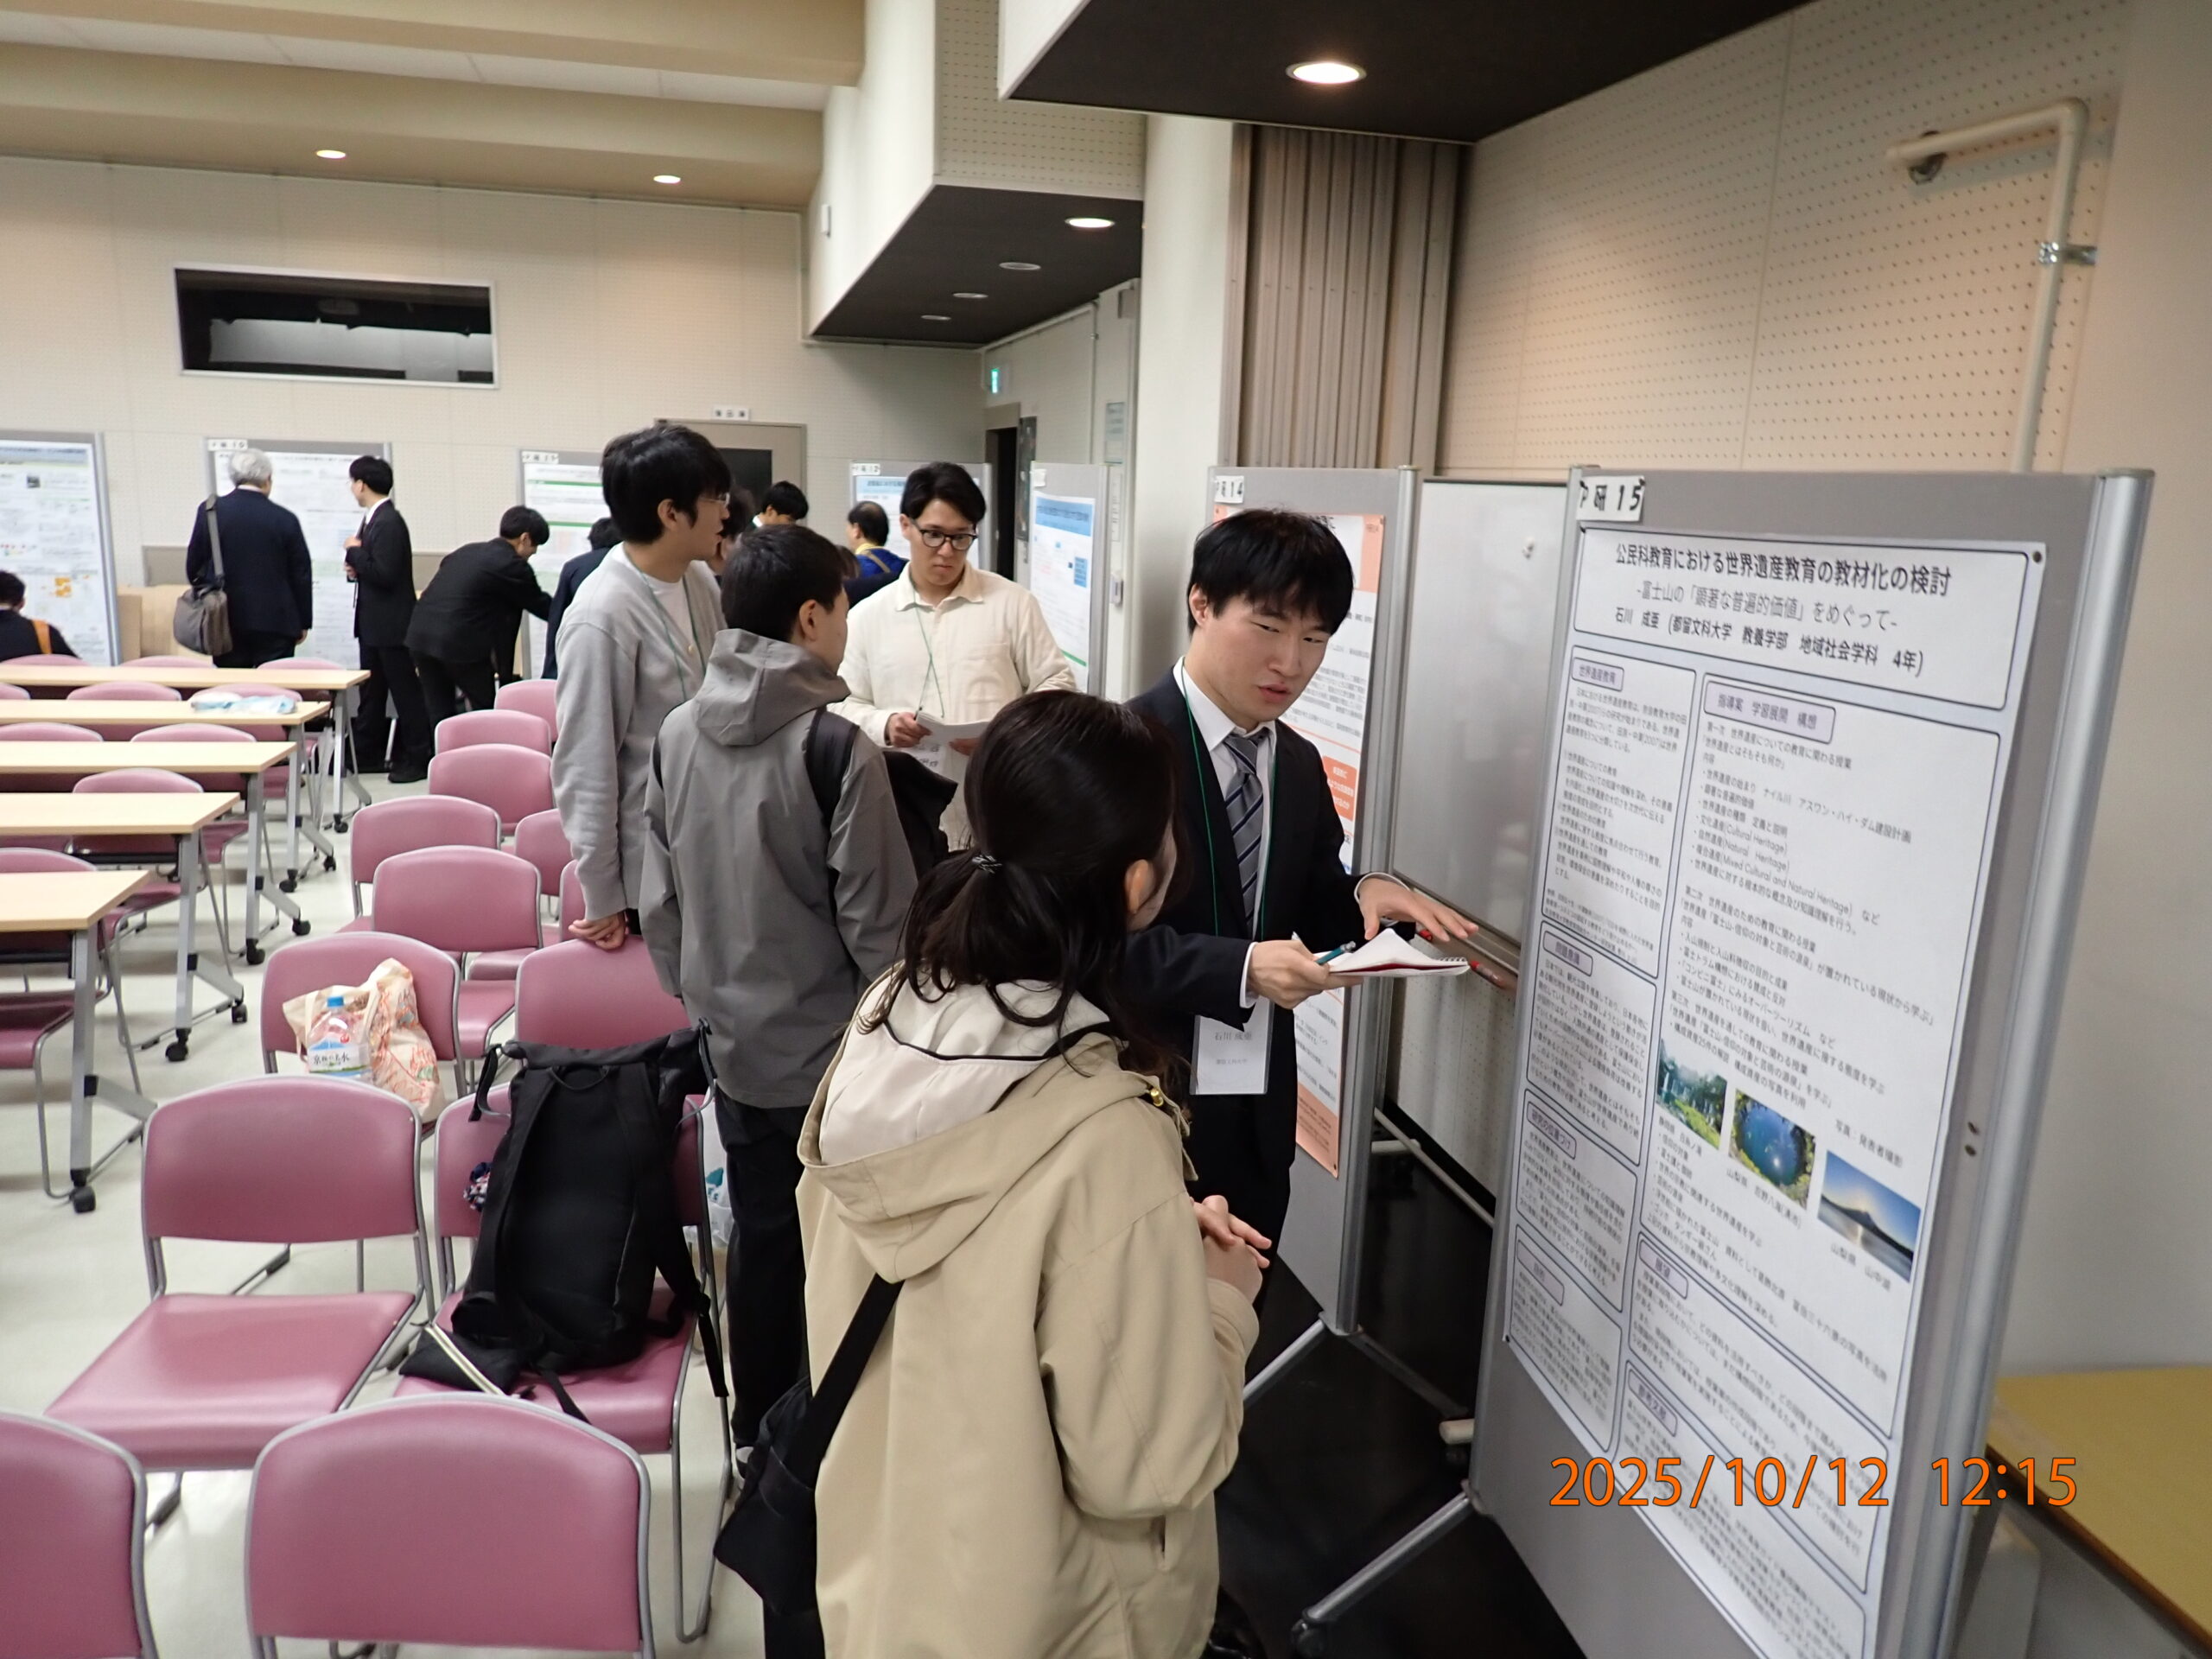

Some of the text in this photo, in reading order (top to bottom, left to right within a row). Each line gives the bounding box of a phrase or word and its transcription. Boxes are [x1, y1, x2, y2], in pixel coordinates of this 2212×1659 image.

[1615, 543, 1951, 596] 公民科教育における世界遺産教育の教材化の検討
[1615, 607, 1633, 625] 石川
[1741, 626, 1789, 650] 教養学部
[1798, 633, 1878, 667] 地域社会学科
[1716, 692, 1818, 730] 指導案 学習展開 構想
[1771, 873, 1787, 889] and
